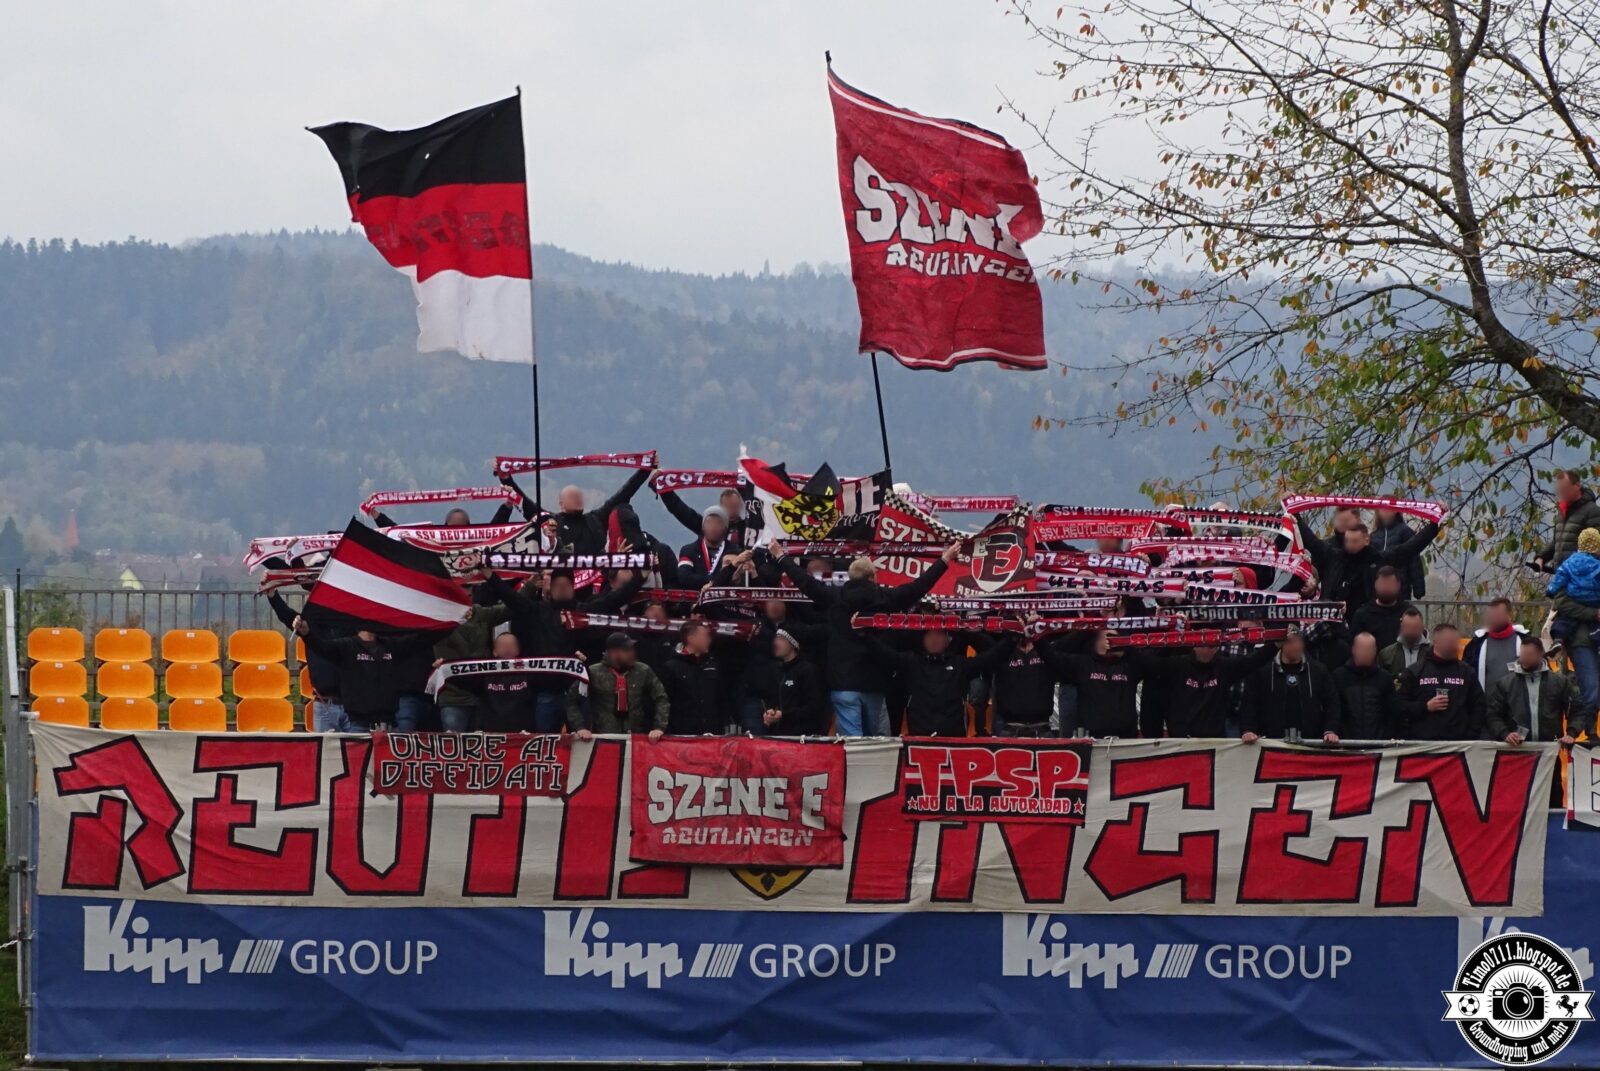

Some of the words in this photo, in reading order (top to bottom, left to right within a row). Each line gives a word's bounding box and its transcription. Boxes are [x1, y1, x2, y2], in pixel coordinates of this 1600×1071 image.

[1053, 506, 1079, 517] SSV
[1083, 507, 1167, 519] REUTLINGEN
[1200, 514, 1222, 523] DER
[1247, 518, 1281, 529] MANN
[416, 530, 436, 541] SSV
[440, 527, 506, 541] REUTLINGEN
[1040, 527, 1060, 538] SSV
[1062, 525, 1127, 536] REUTLINGEN
[490, 553, 645, 568] REUTLINGEN
[1088, 553, 1148, 575] SZENE
[941, 601, 979, 610] SZENE
[1006, 600, 1082, 610] REUTLINGEN
[1086, 599, 1116, 608] 2005
[450, 661, 497, 674] SZENE
[501, 661, 510, 670] E
[528, 660, 584, 674] ULTRAS
[387, 733, 506, 760] ONORE
[521, 734, 562, 762] AI
[381, 760, 563, 790] DIFFIDATI
[908, 745, 1082, 800] TPSP
[647, 765, 790, 825] SZENE
[801, 773, 829, 831] E
[917, 795, 940, 812] NO
[945, 796, 957, 812] A
[964, 795, 984, 812] LA
[989, 797, 1072, 815] AUTORIDAD
[662, 826, 813, 847] REUTLINGEN
[82, 899, 223, 984] Kipp
[290, 939, 438, 976] GROUP
[542, 908, 683, 989] Kipp
[749, 943, 897, 978] GROUP
[1002, 914, 1139, 988] Kipp
[1204, 945, 1352, 980] GROUP
